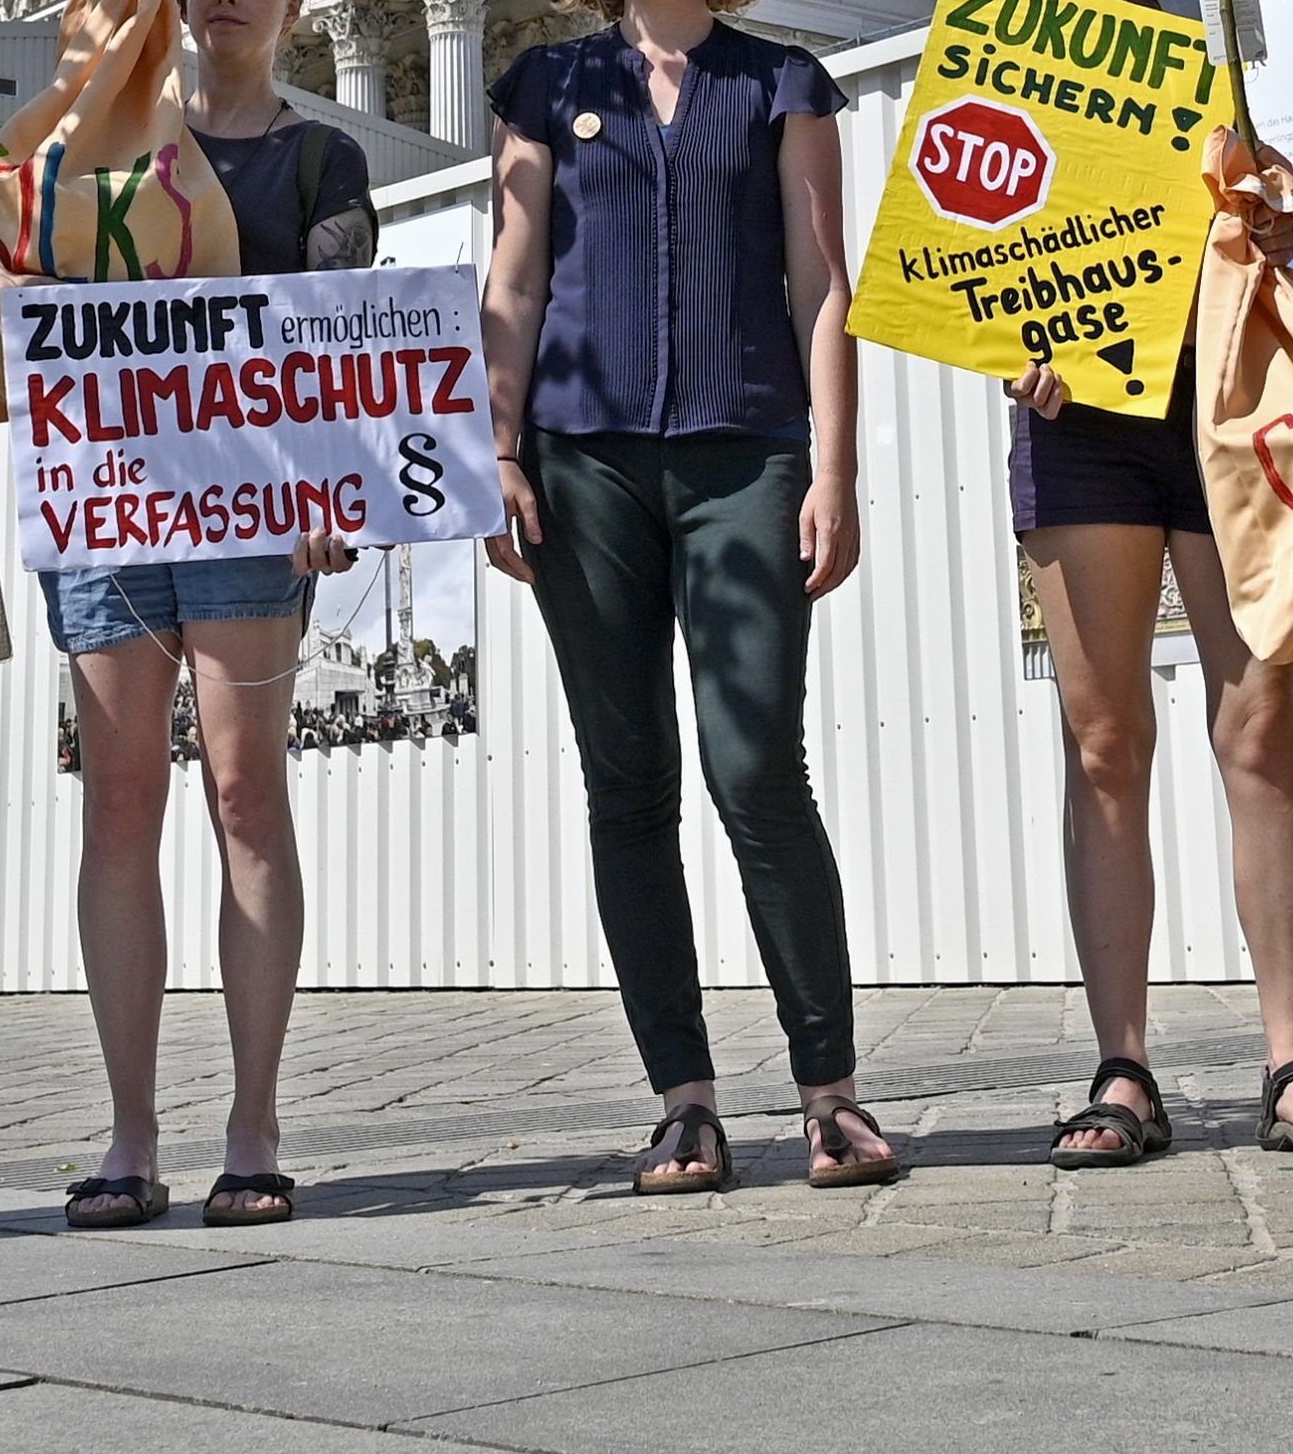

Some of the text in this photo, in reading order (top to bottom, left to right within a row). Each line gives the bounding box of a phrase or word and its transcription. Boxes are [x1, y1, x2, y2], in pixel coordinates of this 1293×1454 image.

[924, 124, 1037, 196] STOP
[900, 203, 1165, 284] klimaschädlicher
[950, 248, 1182, 323] Treibhaus-
[21, 293, 269, 362] ZUKUNFT
[281, 296, 441, 349] ermöglichen
[1022, 301, 1129, 366] gase
[26, 346, 476, 447] KLIMASCHUTZ
[36, 448, 147, 493] in die
[40, 472, 367, 555] VERFASSUNG
